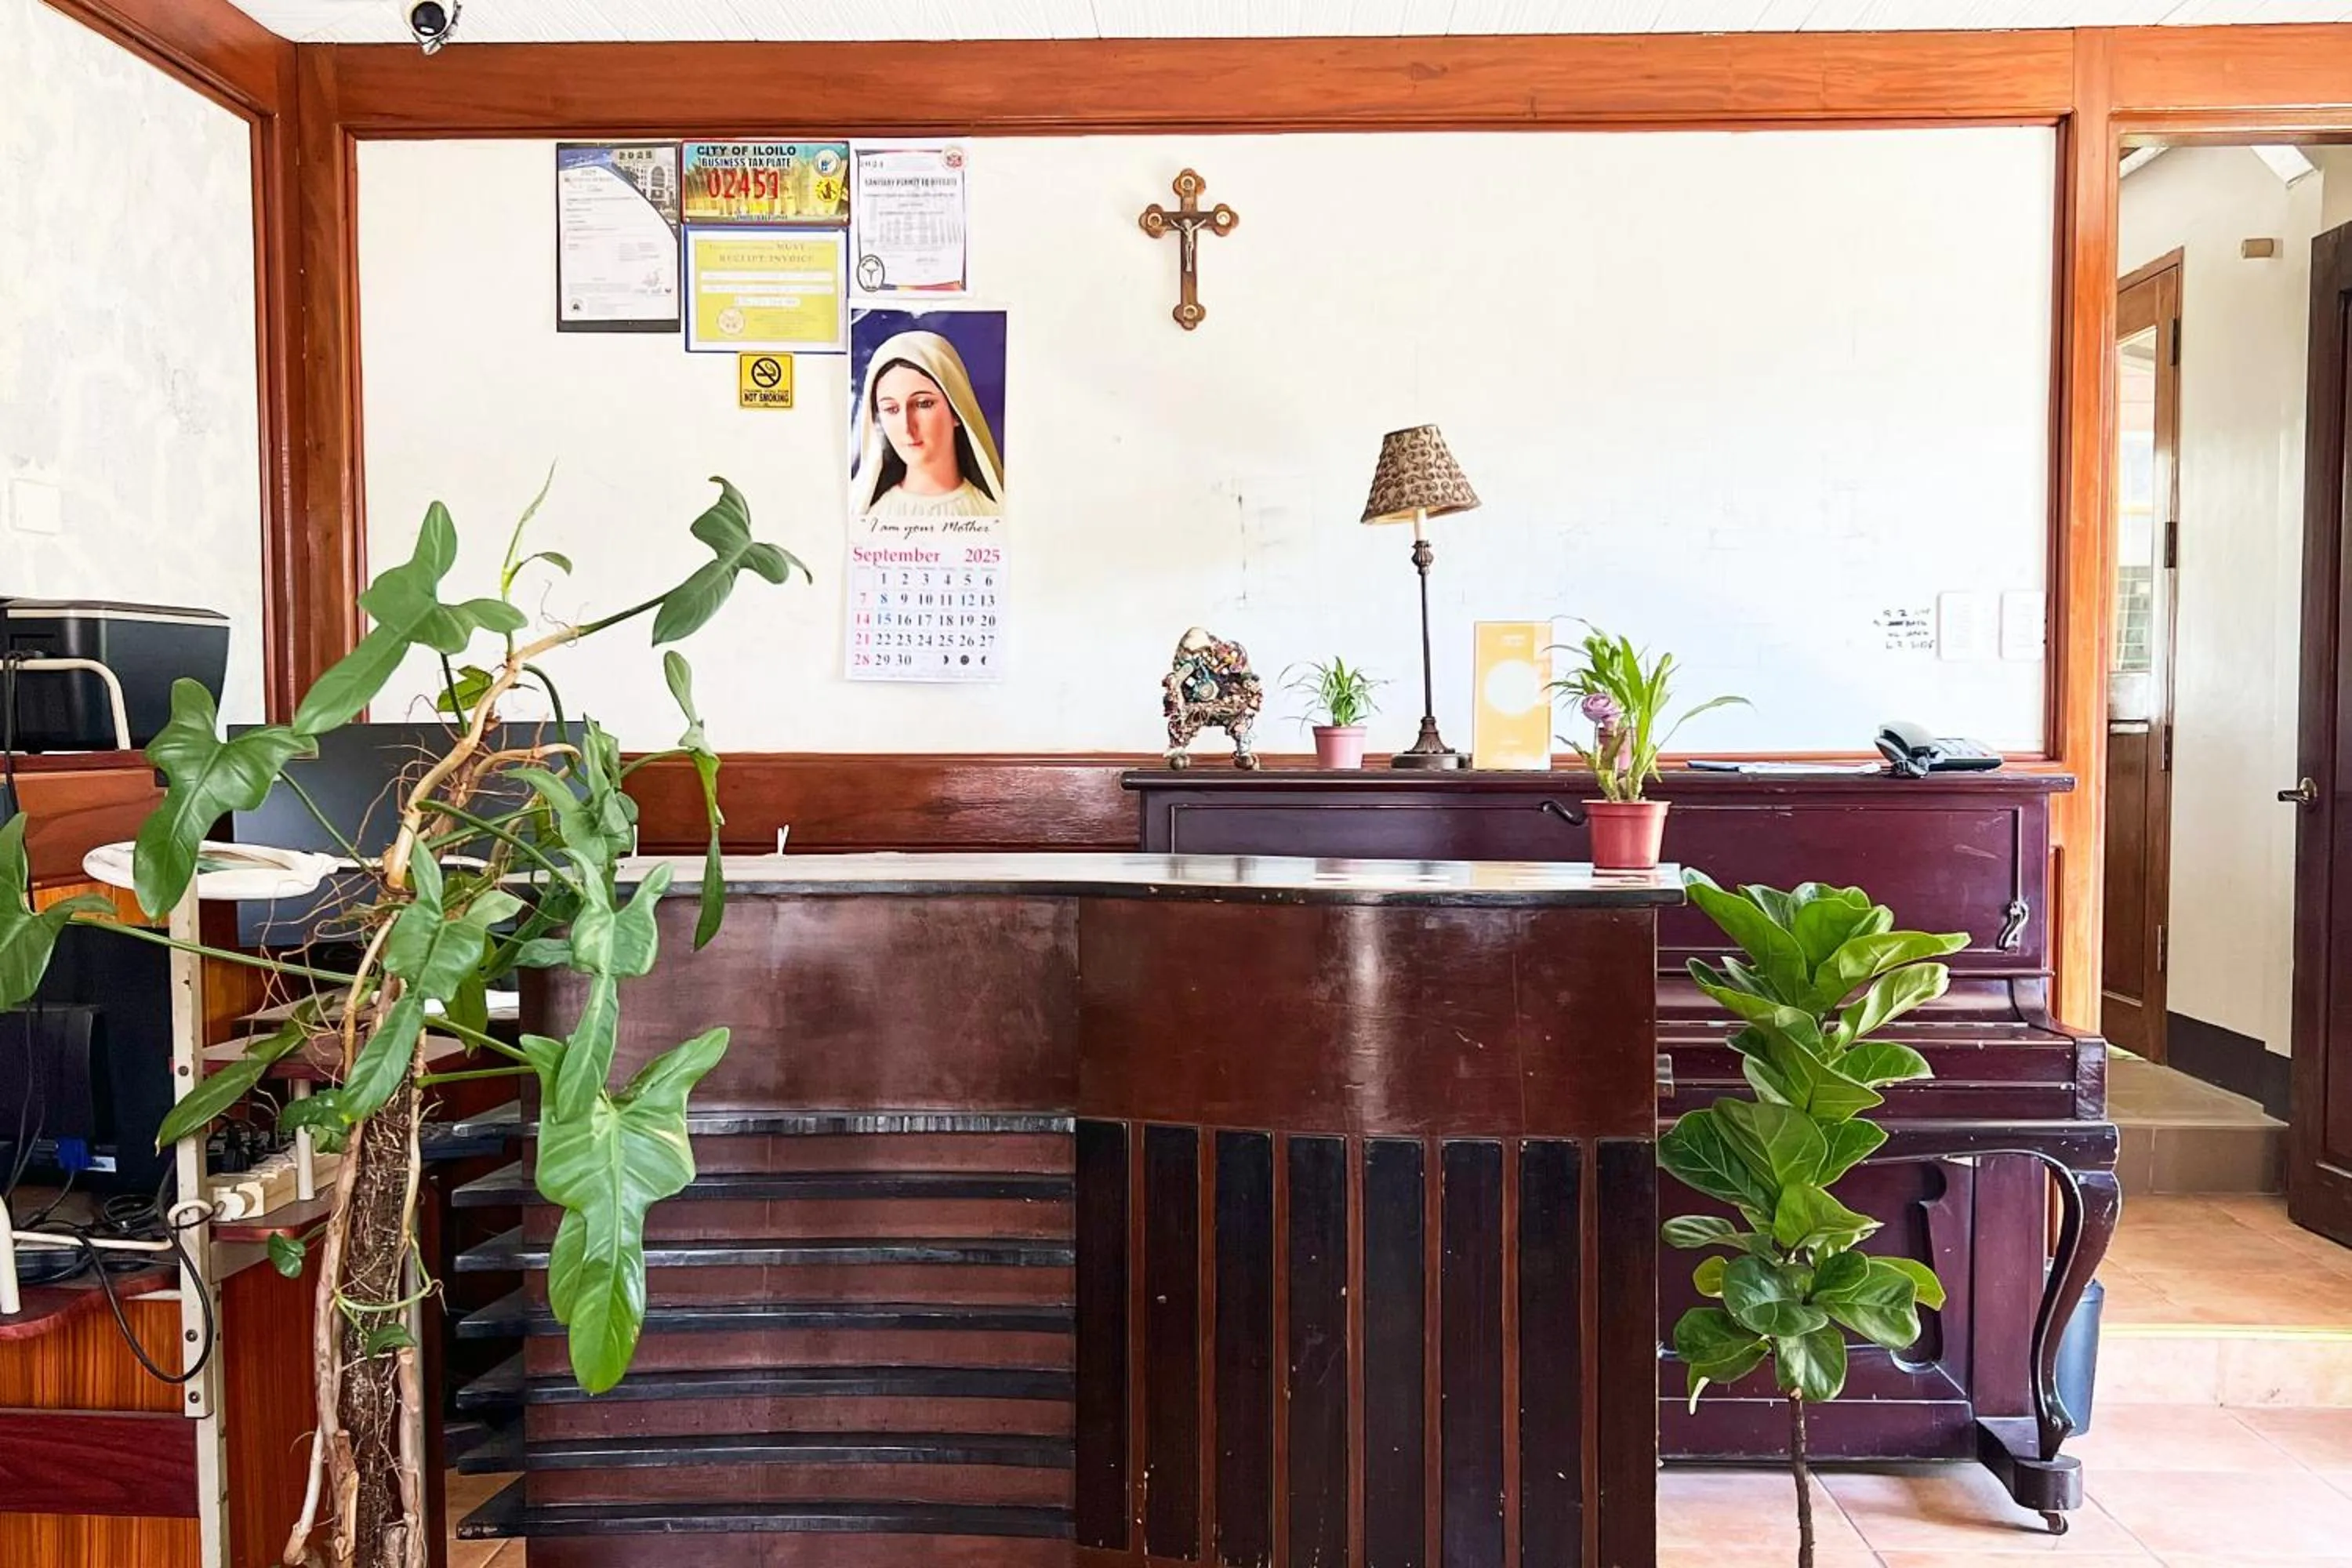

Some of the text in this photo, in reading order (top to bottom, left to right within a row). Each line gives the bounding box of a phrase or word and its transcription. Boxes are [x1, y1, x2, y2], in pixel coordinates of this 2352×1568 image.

[696, 145, 797, 156] CITY OF ILOILO
[702, 157, 791, 168] BUSINESS TAX PLATE
[904, 524, 934, 540] your
[853, 546, 1000, 564] September 2025
[881, 573, 993, 586] 1 2 3 4 5 6
[880, 593, 888, 604] 8
[901, 593, 909, 604] 9
[919, 593, 933, 606] 10
[940, 593, 953, 606] 11
[961, 594, 975, 607] 12
[980, 594, 996, 607] 13
[856, 614, 996, 627] 14 15 16 17 18 19 20
[855, 633, 996, 648] 21 22 23 24 25 26 27
[854, 654, 913, 666] 28 29 30
